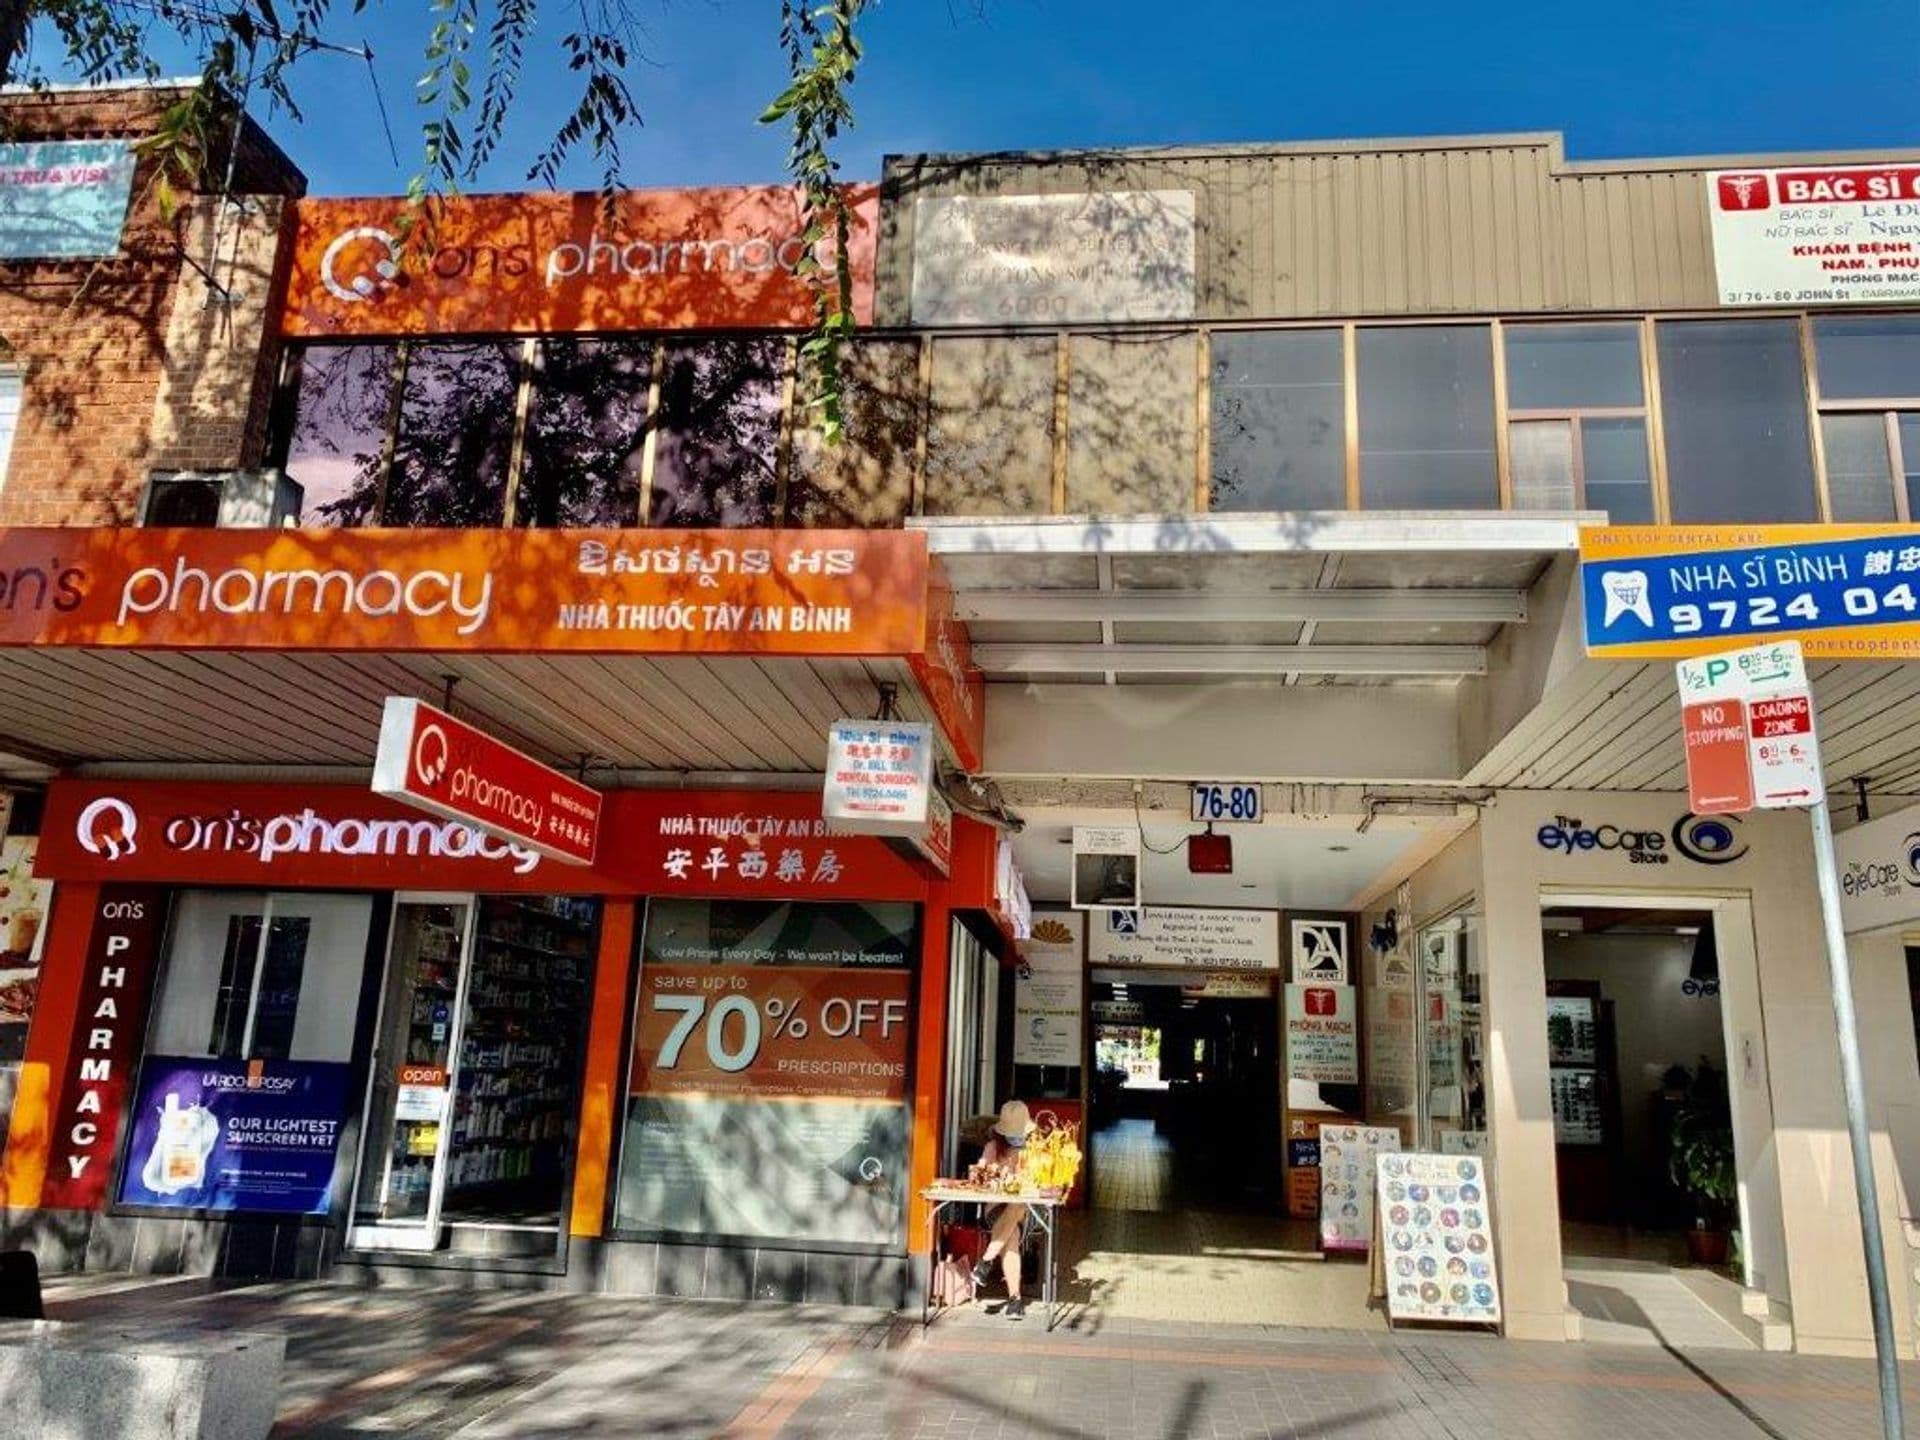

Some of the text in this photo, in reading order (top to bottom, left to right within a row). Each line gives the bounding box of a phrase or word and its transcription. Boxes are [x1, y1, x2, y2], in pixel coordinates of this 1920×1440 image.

[1787, 175, 1857, 201] BÁC
[1670, 550, 1849, 594] NHA SĨ BÌNH
[117, 556, 491, 635] pharmacy
[558, 598, 609, 631] NHÀ
[616, 598, 696, 632] THUỐC
[749, 606, 782, 632] AN
[789, 601, 851, 633] BÌNH
[1668, 583, 1918, 633] 9724 04
[1701, 707, 1724, 726] NO
[1751, 698, 1807, 719] LOADING
[1689, 726, 1745, 746] STOPPING
[1763, 719, 1799, 736] ZONE
[450, 766, 543, 836] pharmacy
[1197, 786, 1256, 818] 76-80
[659, 814, 694, 835] NHÀ
[786, 819, 810, 837] AN
[1555, 815, 1582, 828] The
[1537, 825, 1665, 854] eyeCare
[663, 847, 845, 883] 安平西藥房
[1629, 851, 1669, 864] Store
[103, 900, 144, 919] on's
[661, 947, 686, 958] Low
[722, 948, 752, 961] Every
[753, 948, 776, 962] Day
[842, 951, 856, 962] be
[859, 952, 903, 964] beaten!
[654, 976, 748, 991] save up to
[821, 997, 907, 1040] OFF
[68, 936, 130, 1178] PHARMACY
[403, 1070, 442, 1083] open
[778, 1059, 905, 1077] PRESCRIPTIONS
[228, 1117, 338, 1133] OUR LIGHTEST
[227, 1131, 335, 1146] SUNSCREEN YET
